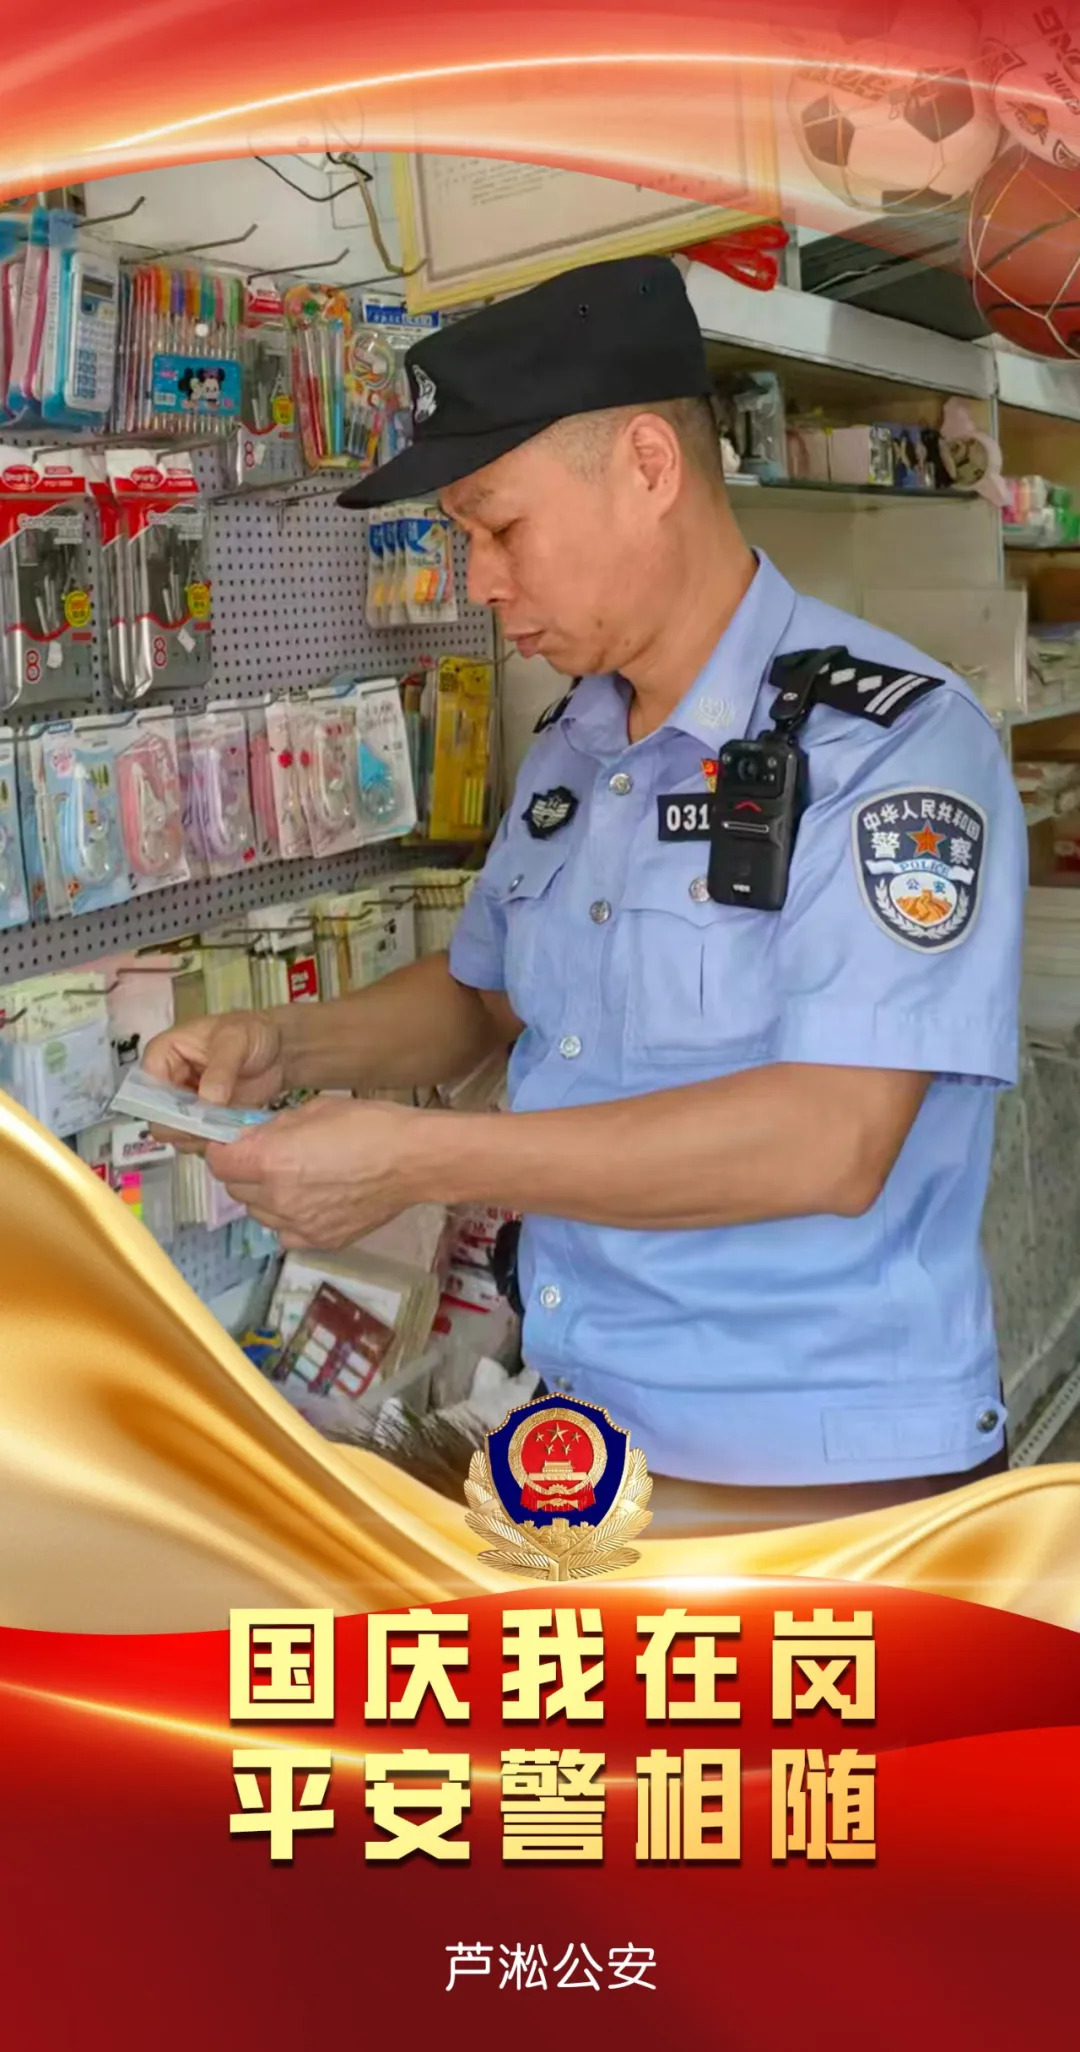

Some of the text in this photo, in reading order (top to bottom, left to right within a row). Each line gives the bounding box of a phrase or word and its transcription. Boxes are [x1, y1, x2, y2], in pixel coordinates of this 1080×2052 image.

[666, 803, 710, 832] 031
[863, 799, 981, 841] 中华人民共和国
[900, 859, 950, 878] POLICE
